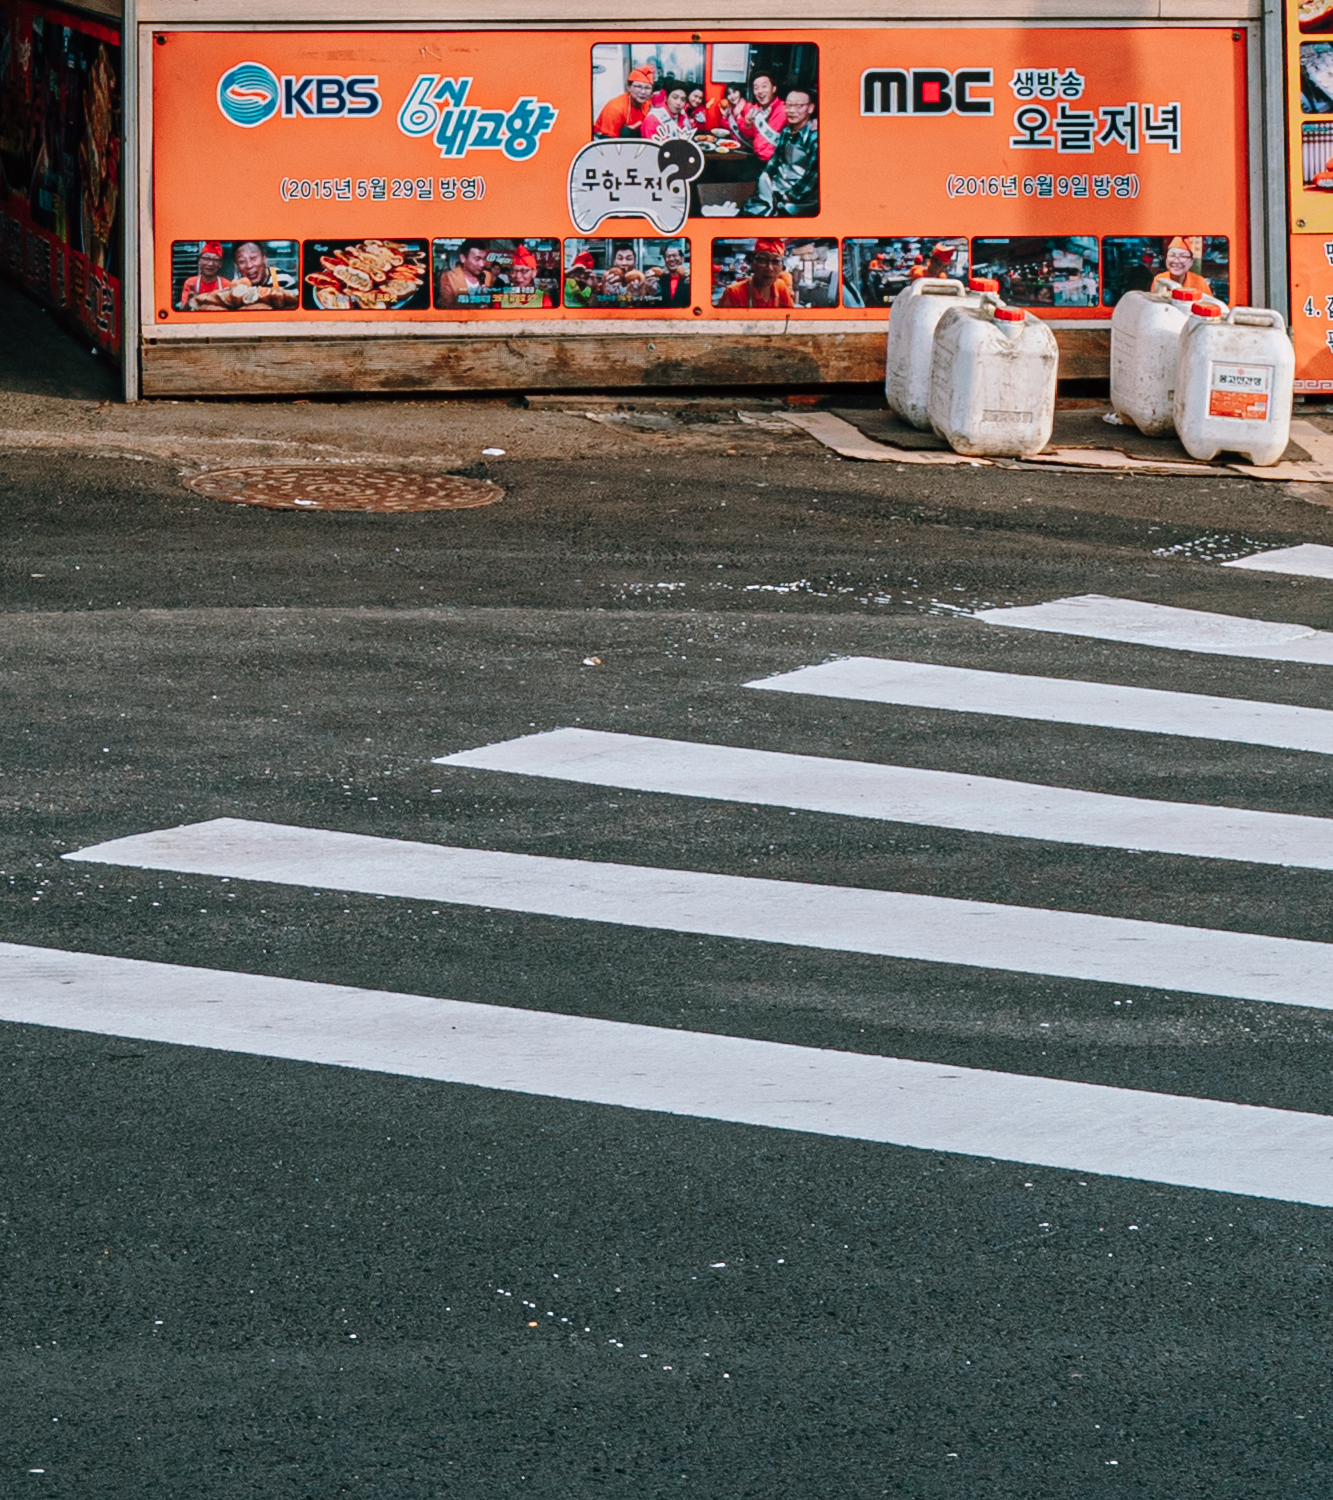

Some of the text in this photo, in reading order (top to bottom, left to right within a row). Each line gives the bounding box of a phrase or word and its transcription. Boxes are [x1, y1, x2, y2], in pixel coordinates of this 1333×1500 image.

[281, 75, 381, 117] KBS
[863, 70, 1084, 116] MBC 생방송
[1011, 104, 1181, 153] 오늘저녁
[280, 176, 486, 201] (2015년 5월 29일 방영)
[582, 168, 664, 202] 무한도전
[946, 174, 1141, 198] (2016년 6월 9일 방영)
